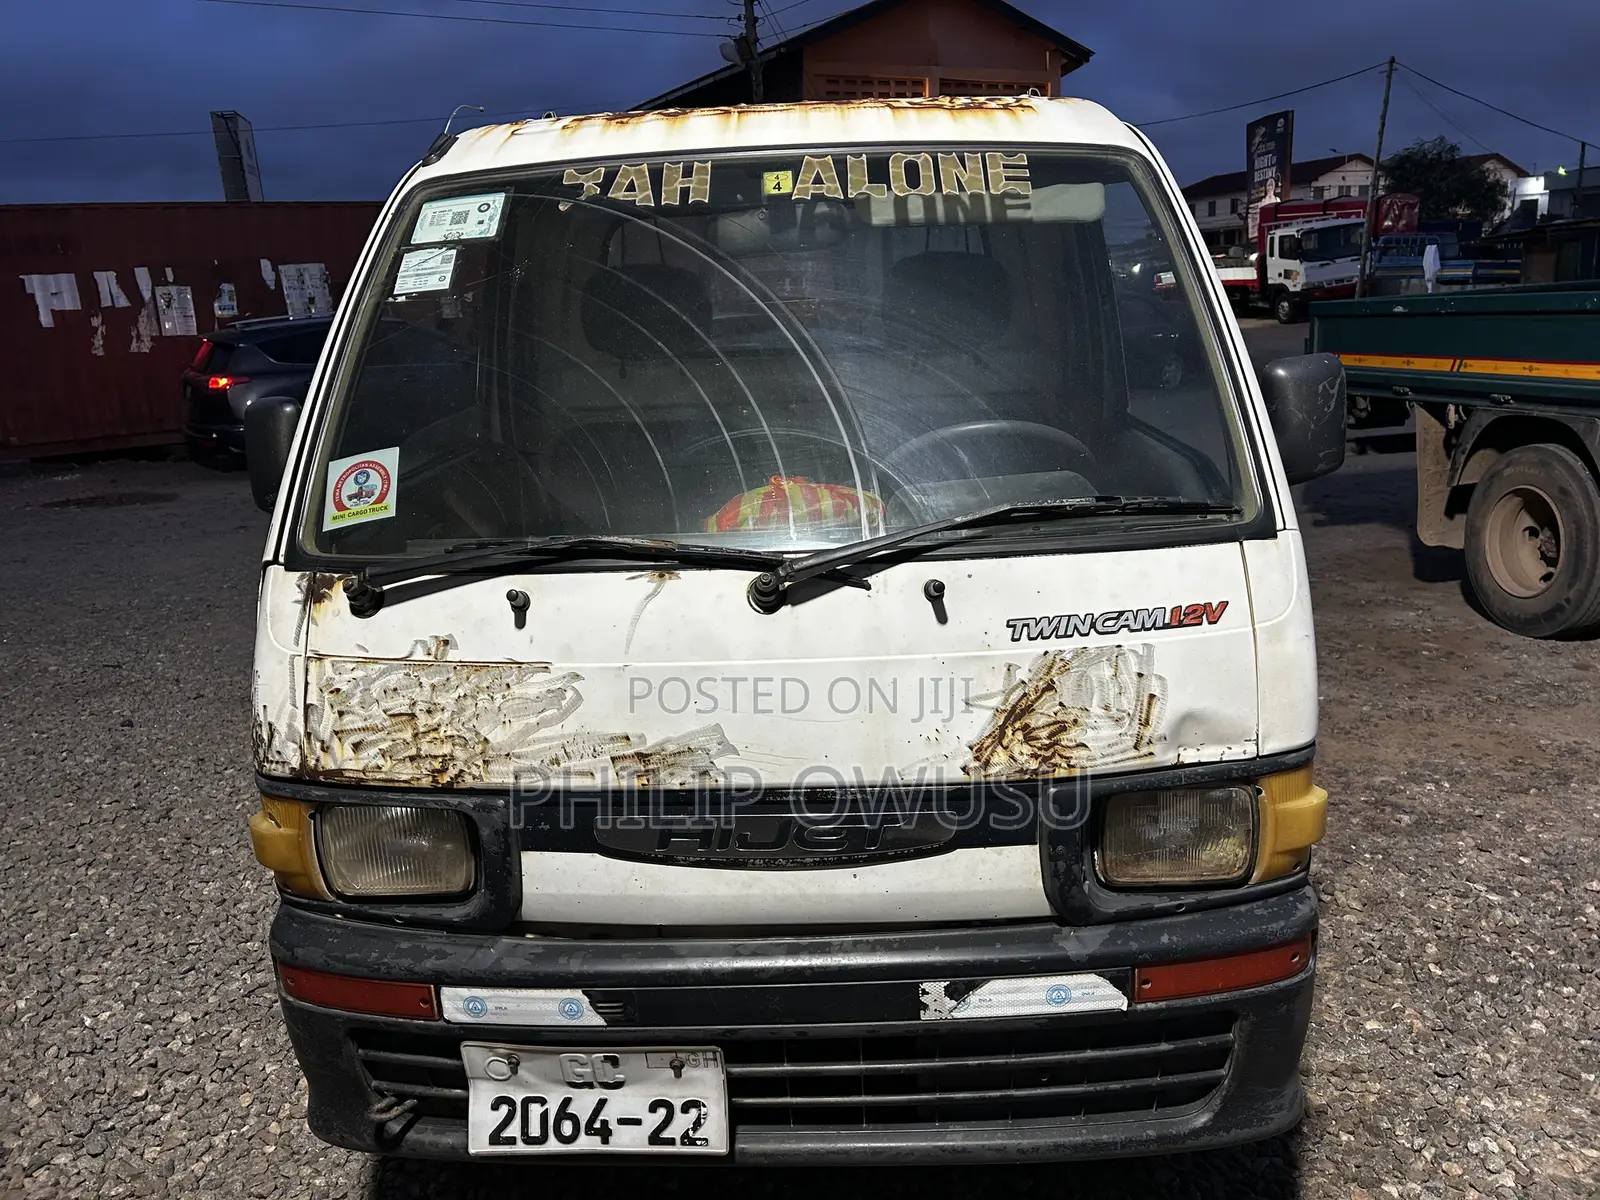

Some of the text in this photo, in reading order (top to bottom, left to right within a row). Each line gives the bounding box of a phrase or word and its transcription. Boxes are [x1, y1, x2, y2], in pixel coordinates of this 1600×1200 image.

[772, 181, 783, 192] 4
[792, 152, 1033, 200] ALONE
[332, 505, 389, 521] MINI CARGO TRUCK
[1168, 600, 1230, 627] 12V
[559, 1051, 719, 1090] GC GH
[488, 1094, 709, 1147] 2064-22
